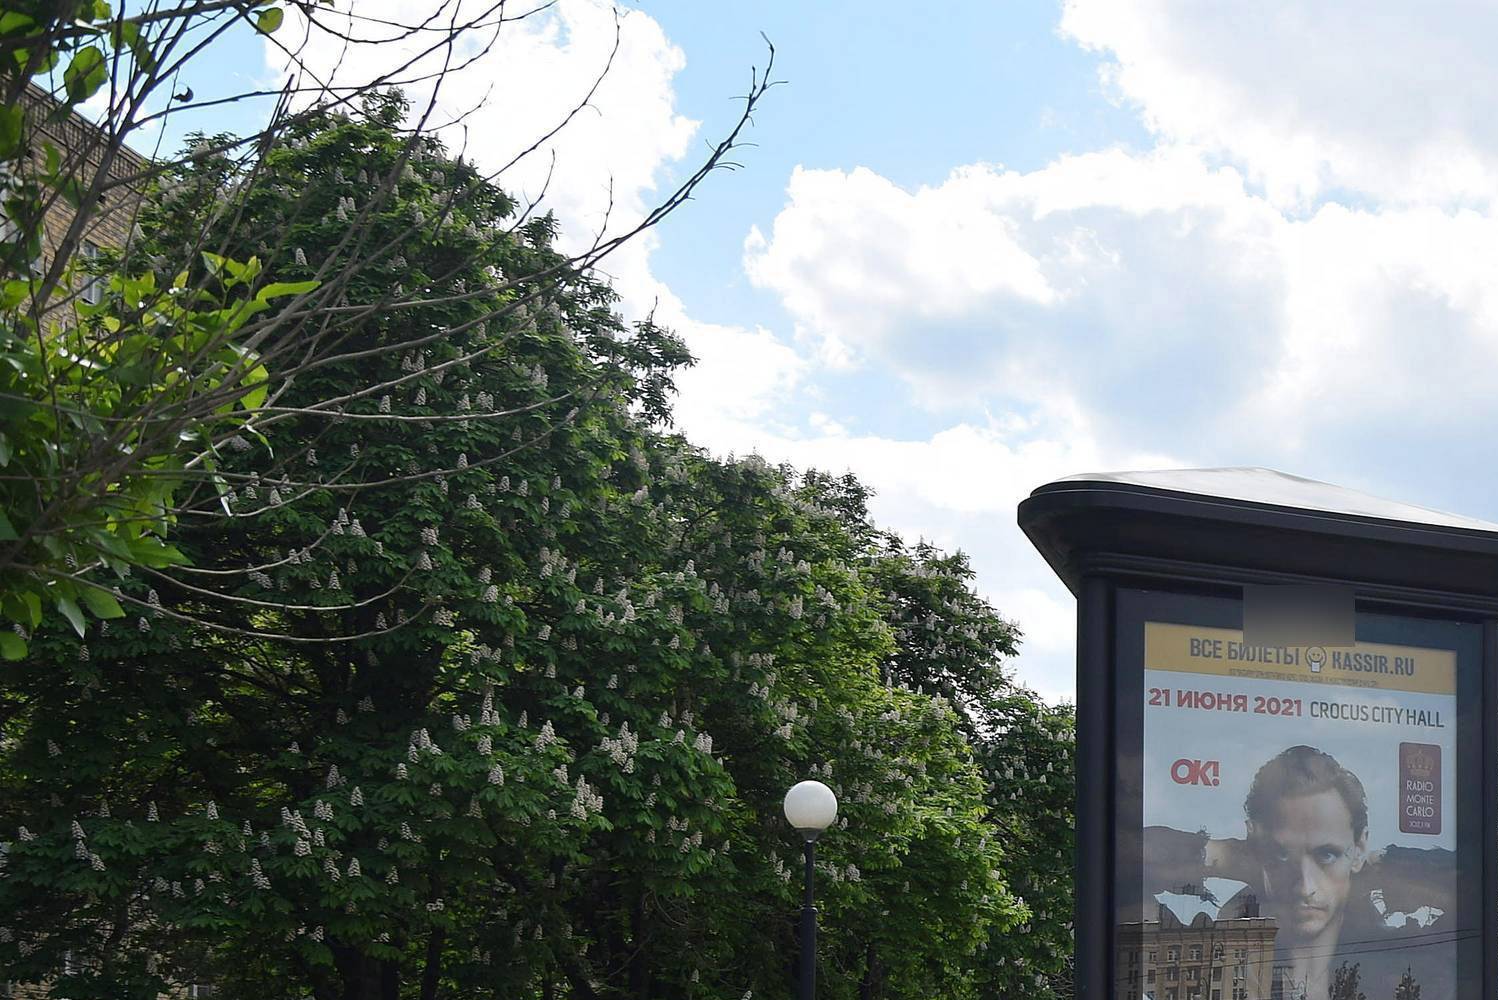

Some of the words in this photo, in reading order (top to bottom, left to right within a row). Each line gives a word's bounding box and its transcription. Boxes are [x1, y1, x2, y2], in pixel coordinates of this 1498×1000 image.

[1190, 637, 1222, 660] ВСЕ
[1228, 642, 1299, 667] БИЛЕТЫ
[1332, 650, 1414, 677] KASSIR.RU
[1149, 688, 1170, 707] 21
[1177, 692, 1247, 713] ИЮНЯ
[1253, 697, 1302, 717] 2021
[1310, 701, 1368, 722] CROCUS
[1372, 708, 1403, 724] CITY
[1406, 711, 1445, 728] HALL
[1170, 758, 1221, 787] OK!
[1406, 780, 1434, 793] RADIO
[1406, 794, 1434, 804] MONTE
[1406, 805, 1434, 818] CARLO
